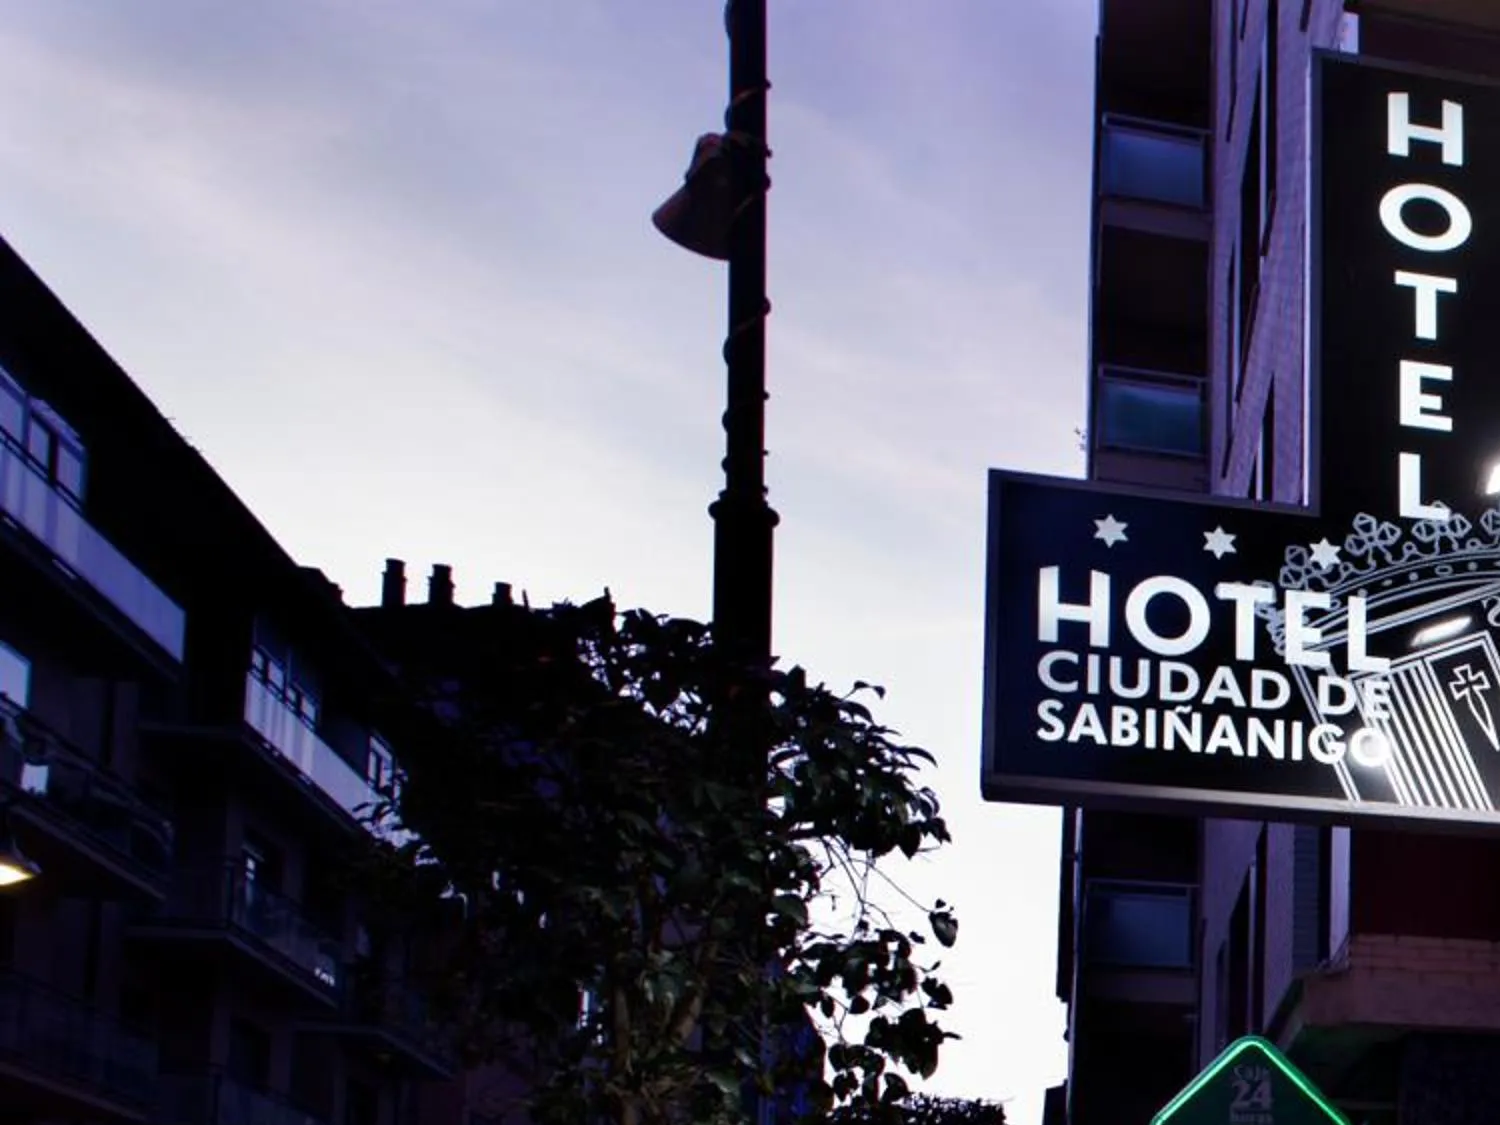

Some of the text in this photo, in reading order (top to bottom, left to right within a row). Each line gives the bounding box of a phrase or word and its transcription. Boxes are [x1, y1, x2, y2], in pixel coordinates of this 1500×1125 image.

[1379, 92, 1472, 520] HOTEL
[1037, 565, 1390, 672] HOTEL
[1037, 652, 1392, 720] CIUDAD DE
[1036, 697, 1391, 767] SABIÑANIGO
[1231, 1079, 1274, 1109] 24
